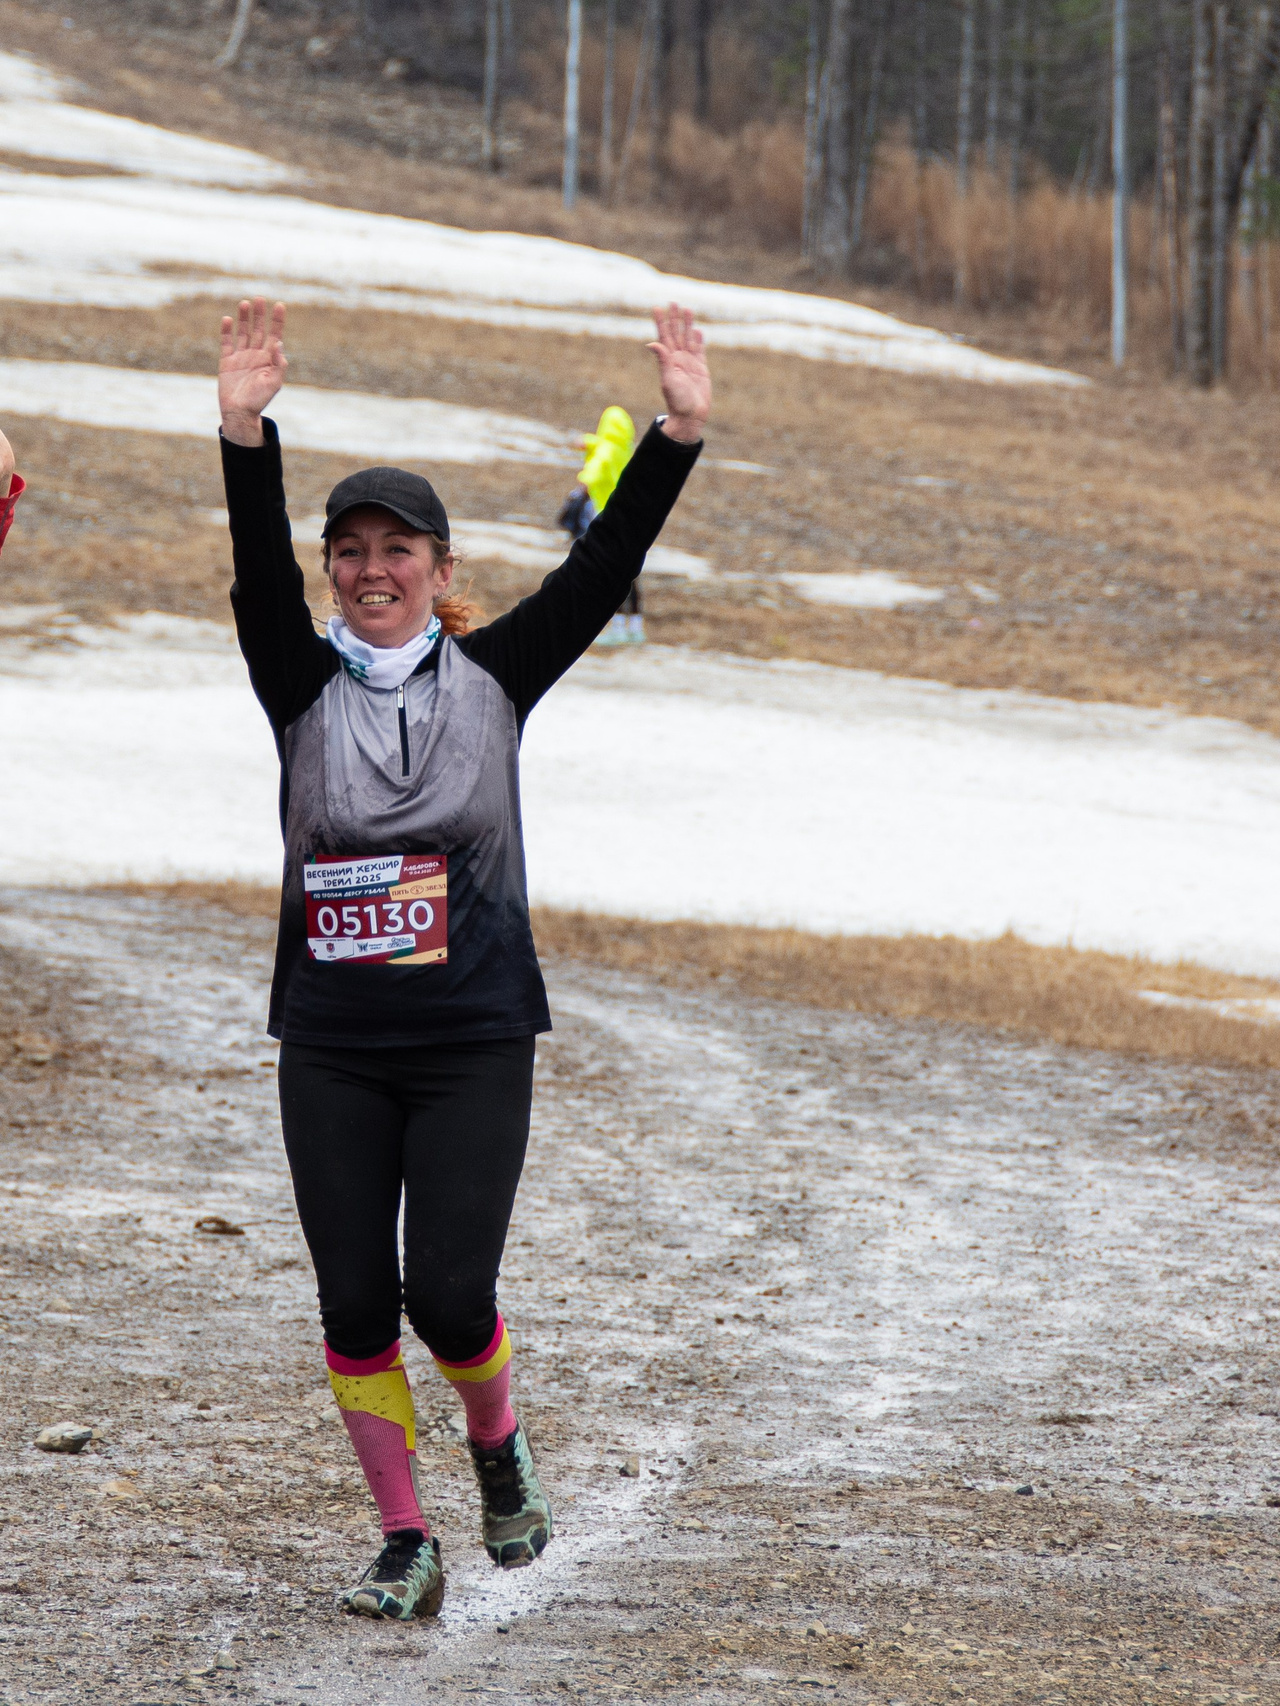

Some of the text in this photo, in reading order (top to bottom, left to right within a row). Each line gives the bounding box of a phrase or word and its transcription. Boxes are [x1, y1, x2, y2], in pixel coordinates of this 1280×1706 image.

[306, 860, 400, 879] ВЕСЕННИЙ ХЕХЦИР
[323, 873, 381, 888] ТРЕЙЛ 2025
[317, 899, 435, 937] 05130
